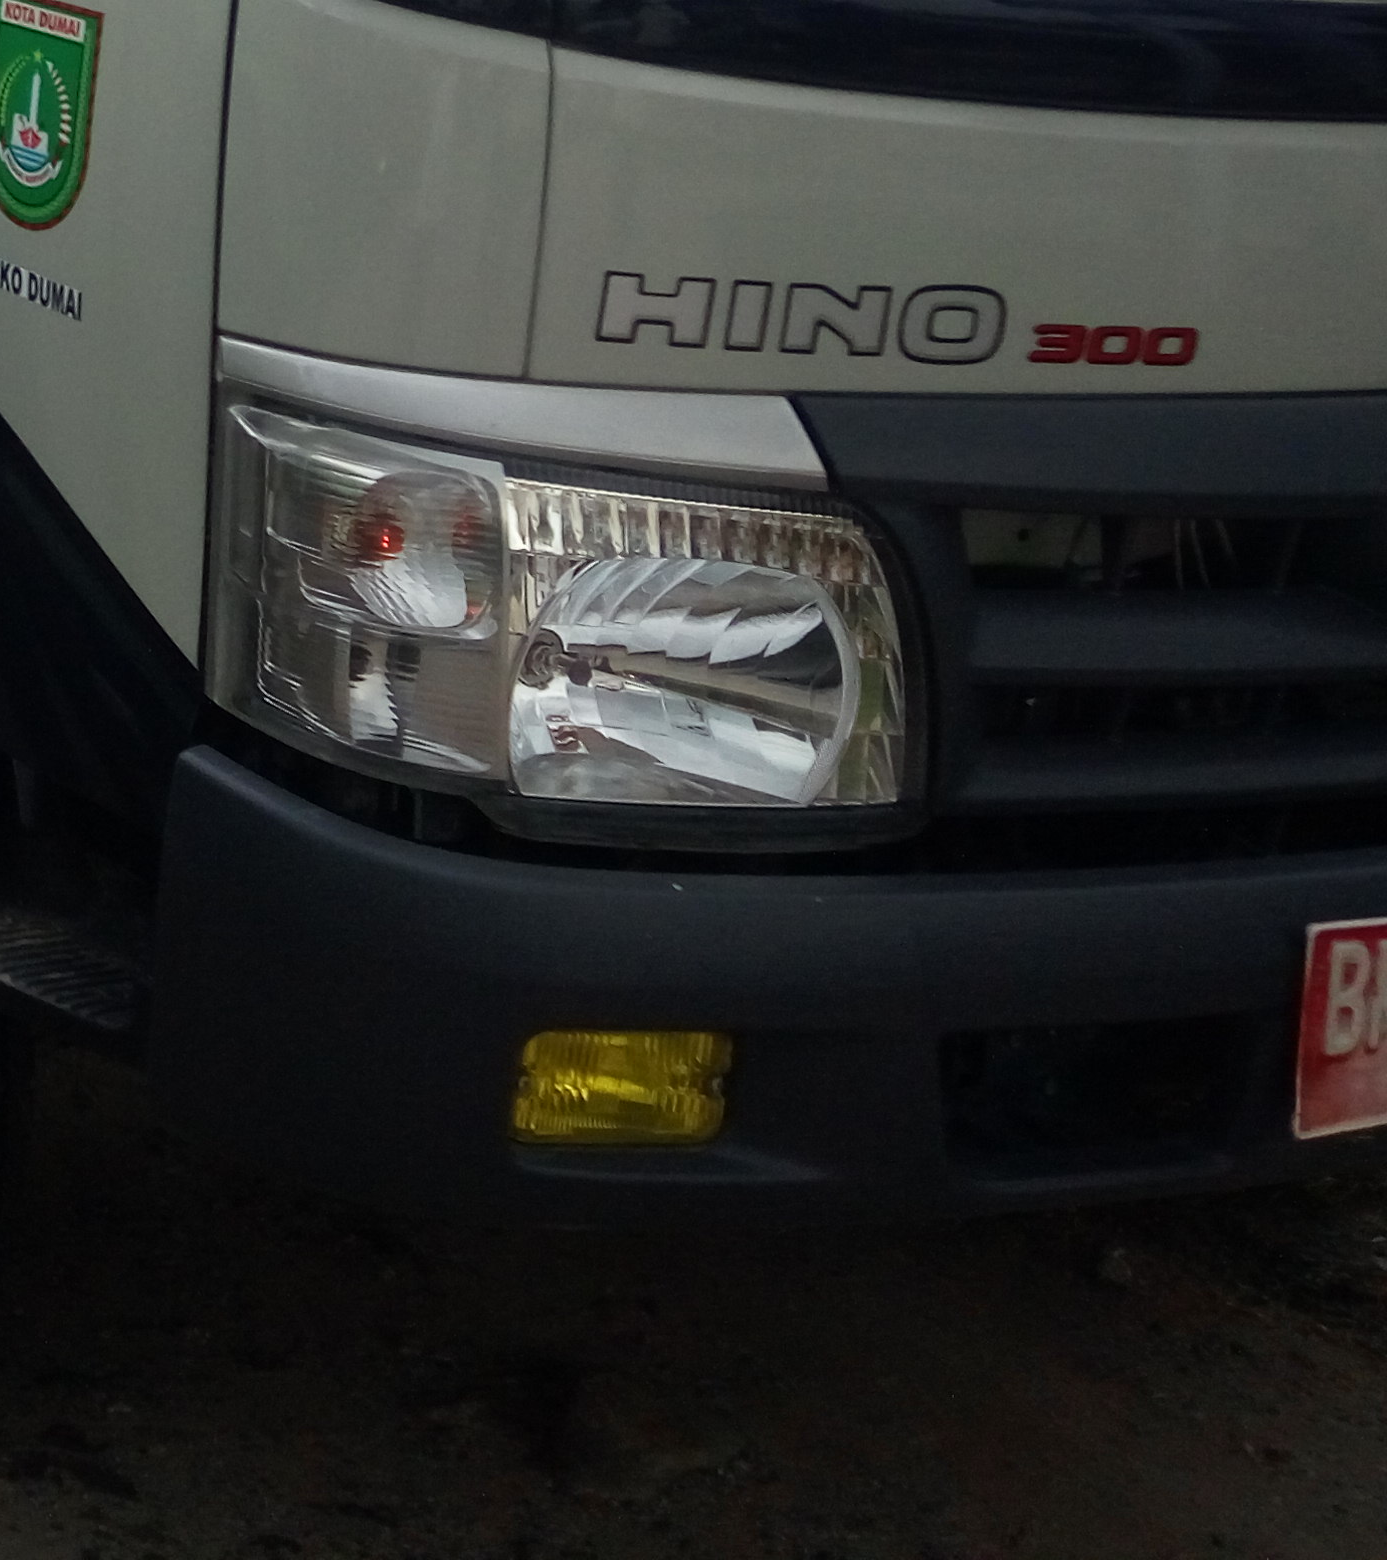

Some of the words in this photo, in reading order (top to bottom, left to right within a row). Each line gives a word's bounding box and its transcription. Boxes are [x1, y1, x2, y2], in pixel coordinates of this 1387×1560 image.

[5, 2, 35, 24] KOTA
[39, 11, 81, 37] DUMAI
[28, 271, 82, 321] DUMAI
[594, 269, 1007, 366] HINO
[1028, 323, 1200, 366] 300
